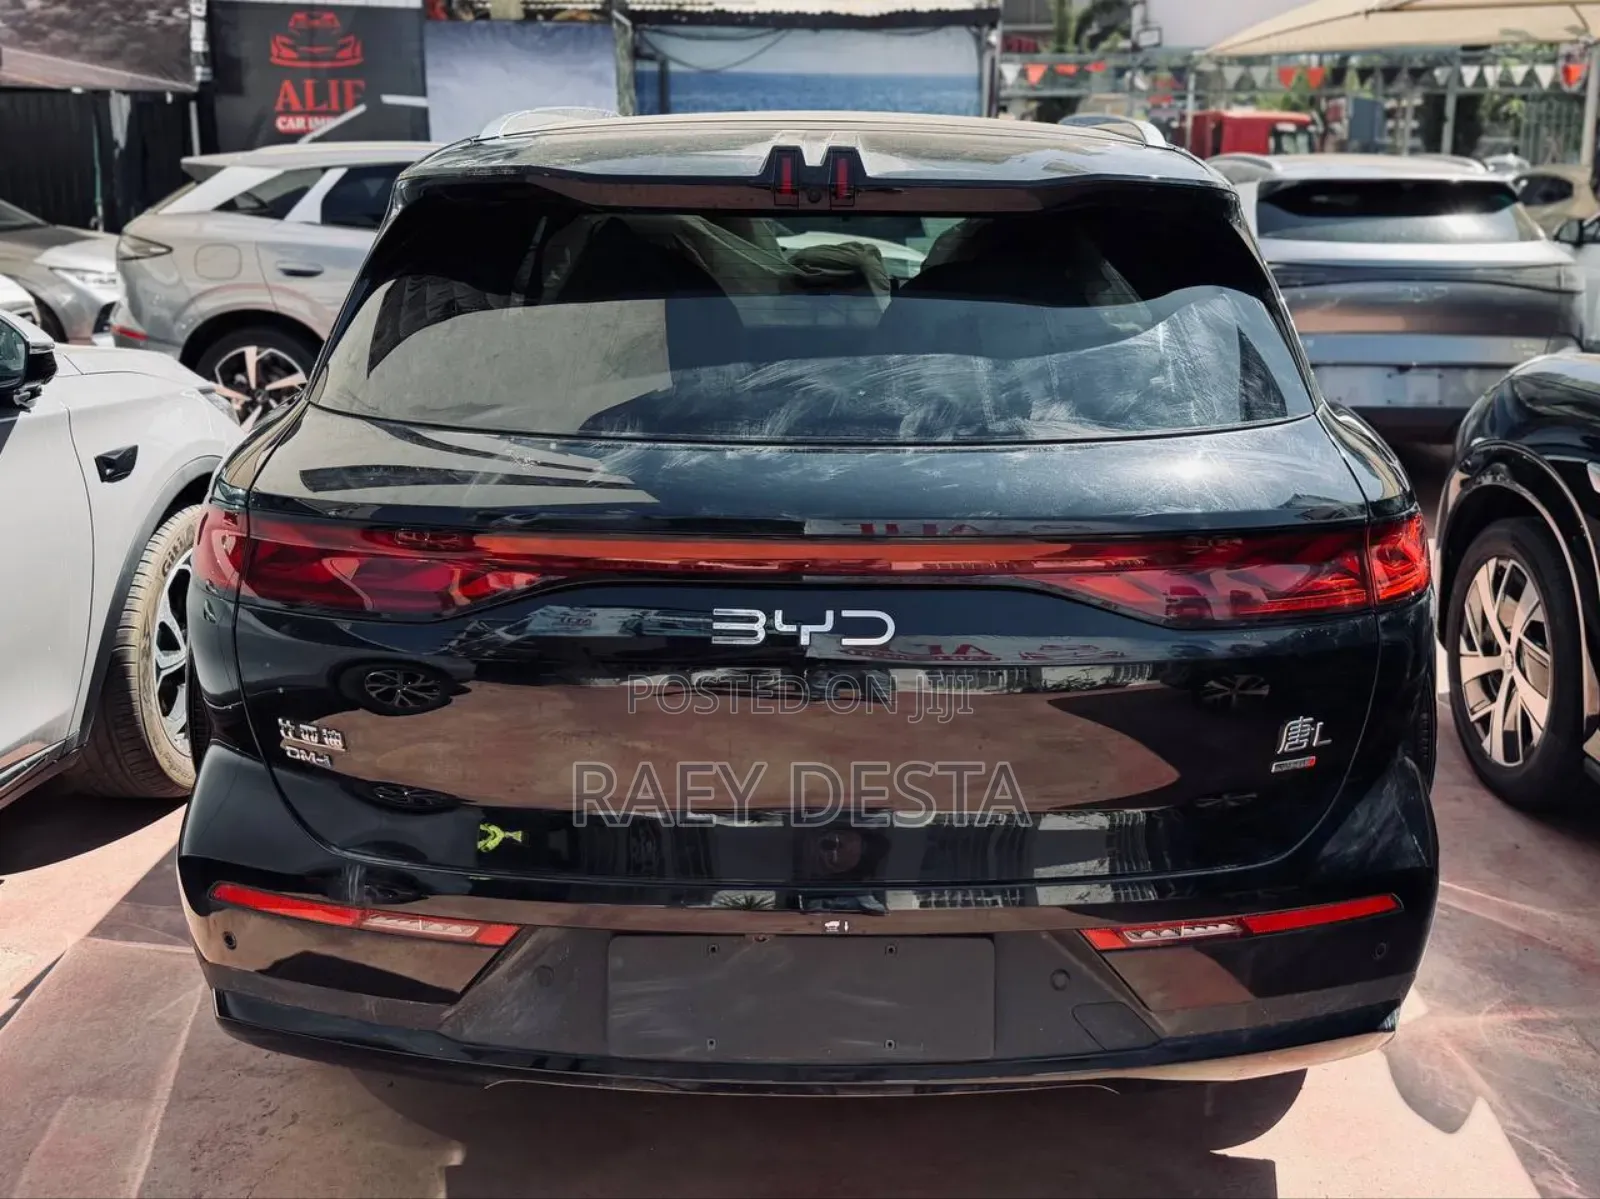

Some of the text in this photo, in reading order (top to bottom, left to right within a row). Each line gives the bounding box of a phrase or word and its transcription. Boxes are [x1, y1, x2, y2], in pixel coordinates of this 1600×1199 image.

[274, 79, 366, 112] ALIF
[276, 115, 306, 131] CAR
[711, 608, 896, 646] BYD
